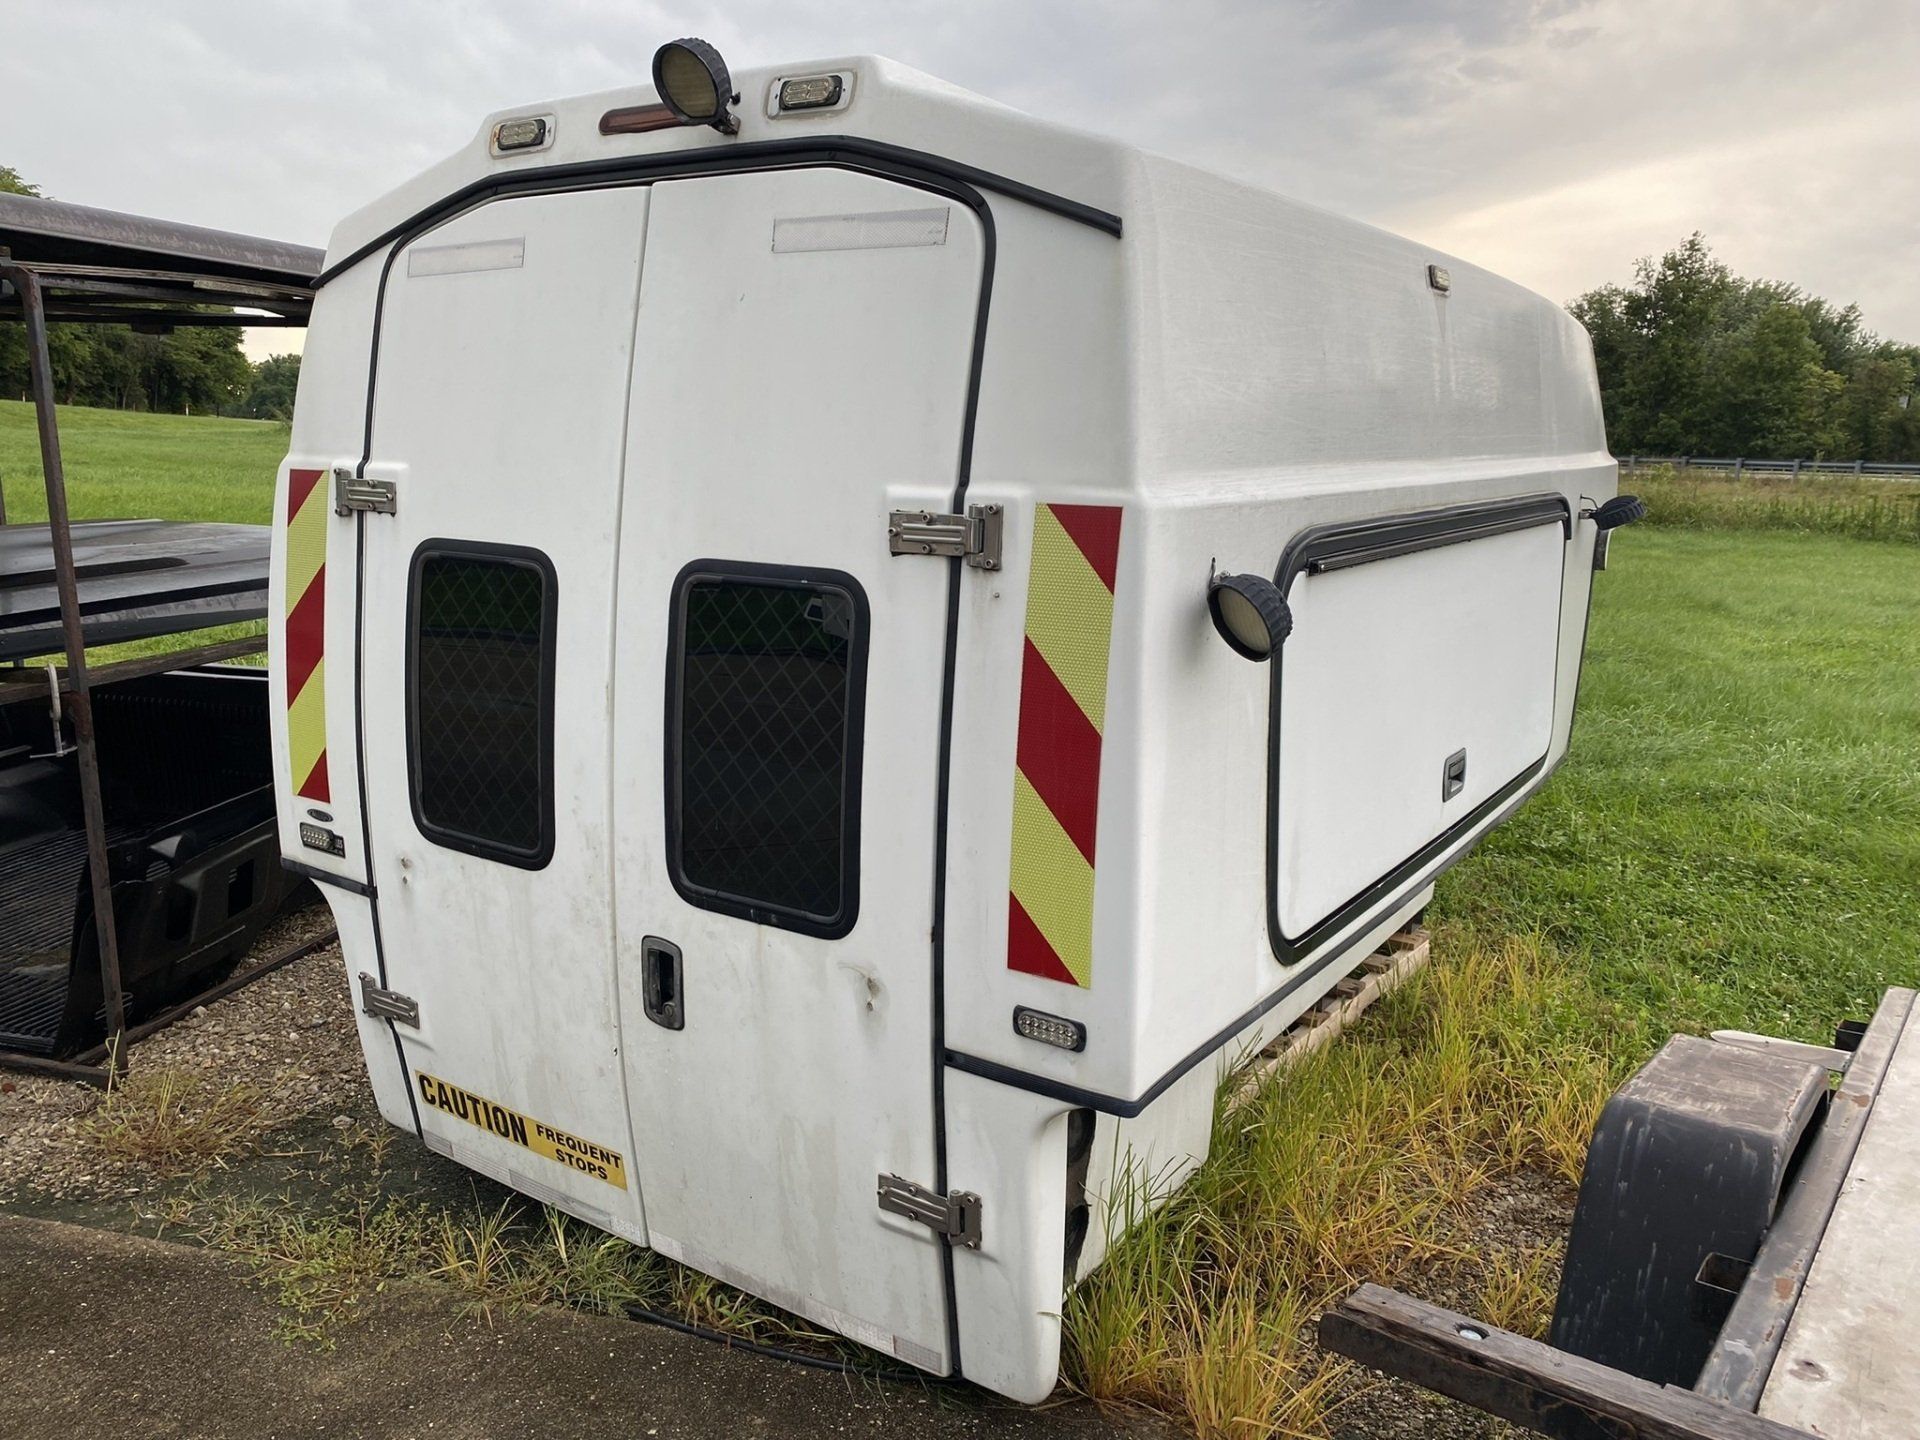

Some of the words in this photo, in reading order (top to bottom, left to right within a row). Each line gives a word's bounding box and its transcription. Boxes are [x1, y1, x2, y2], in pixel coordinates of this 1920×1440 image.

[419, 1075, 529, 1147] CAUTION
[536, 1124, 620, 1168] FREQUENT
[556, 1150, 607, 1180] STOPS
